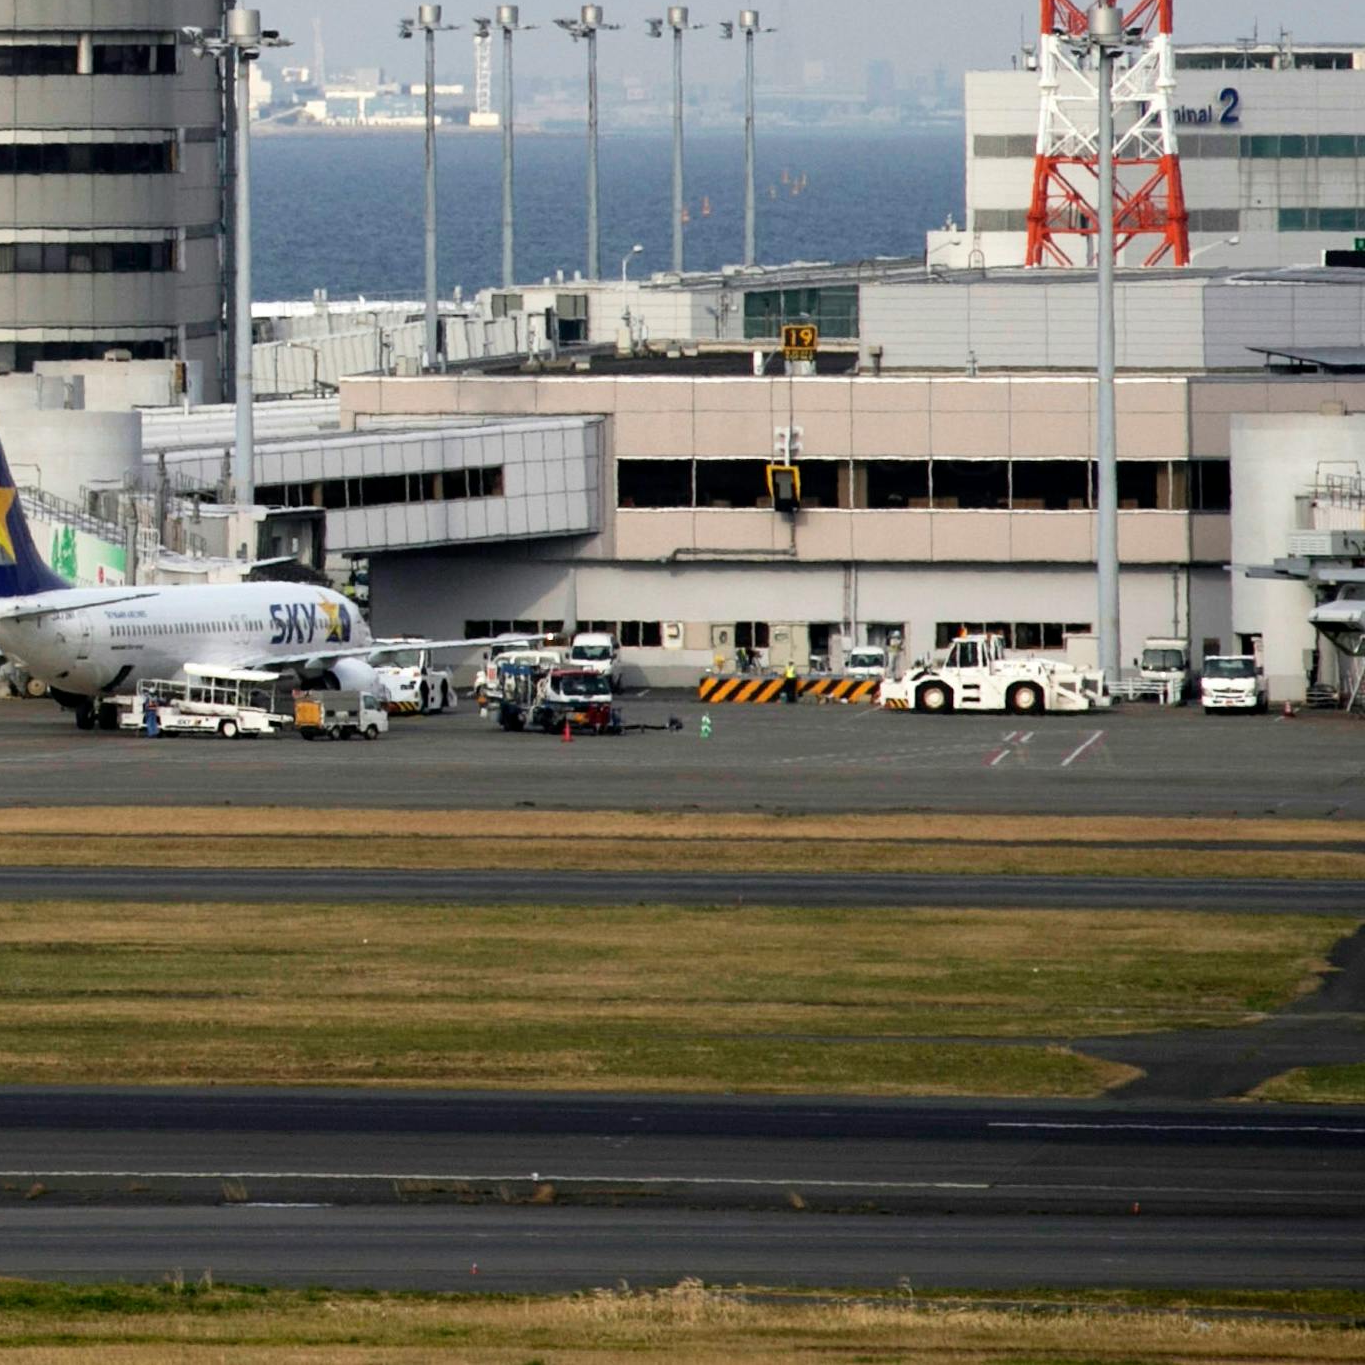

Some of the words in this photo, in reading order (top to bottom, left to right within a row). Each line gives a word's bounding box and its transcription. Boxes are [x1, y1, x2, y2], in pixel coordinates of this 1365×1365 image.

[1139, 100, 1213, 123] Tminal
[1219, 87, 1240, 123] 2
[790, 329, 813, 347] 19
[269, 603, 316, 645] SKY
